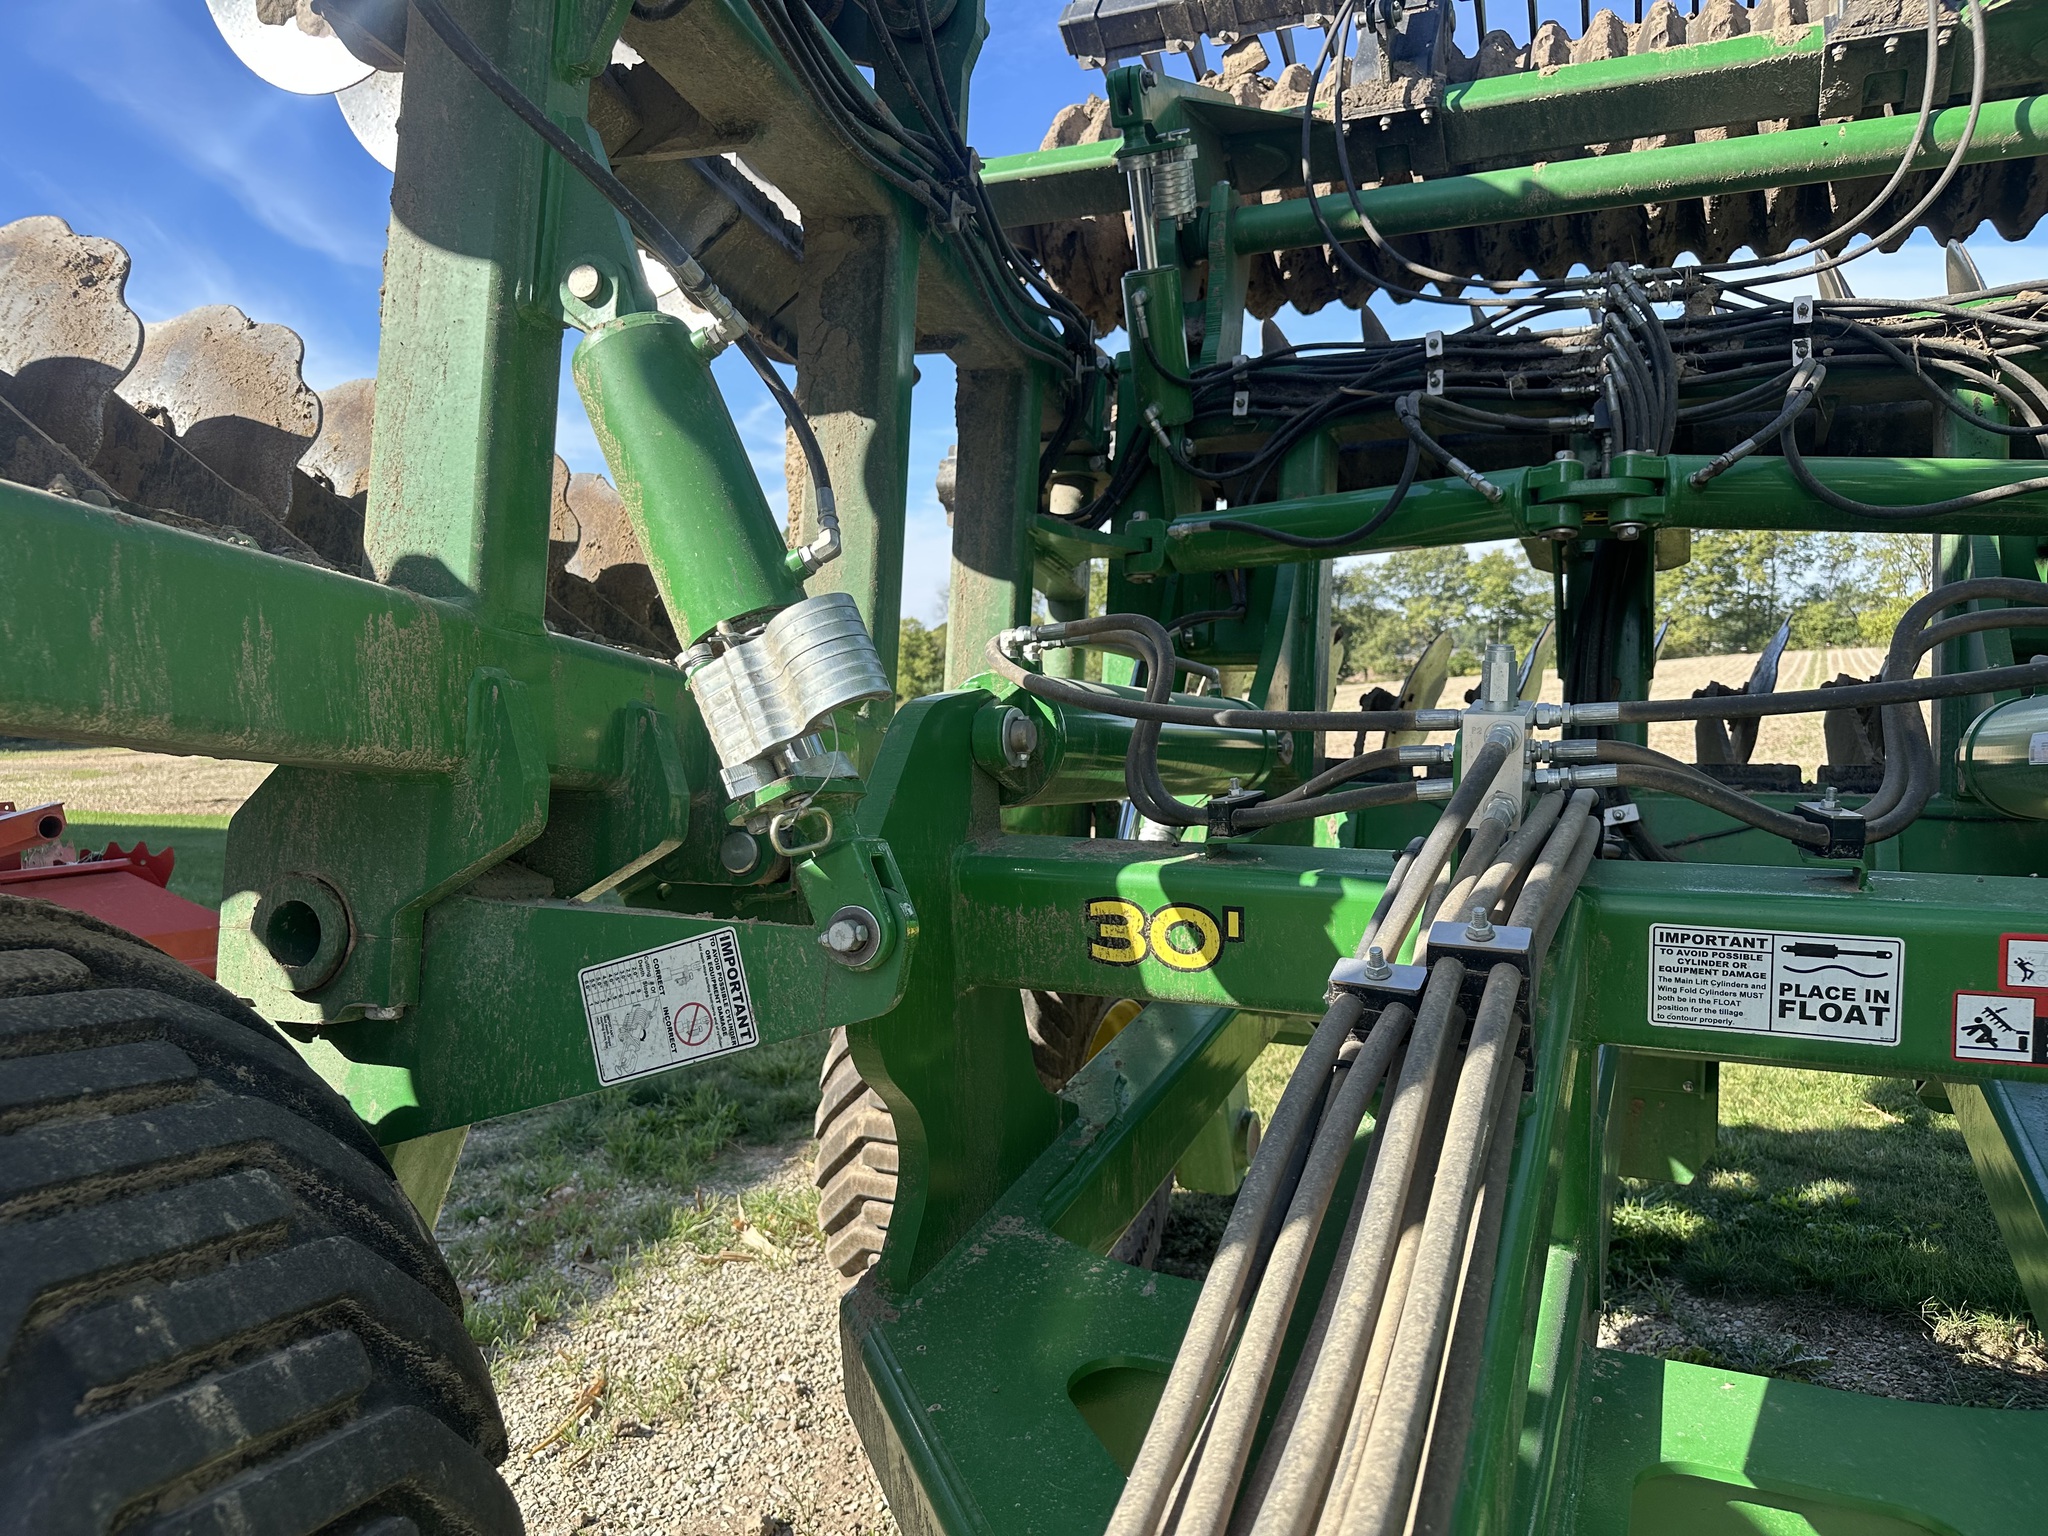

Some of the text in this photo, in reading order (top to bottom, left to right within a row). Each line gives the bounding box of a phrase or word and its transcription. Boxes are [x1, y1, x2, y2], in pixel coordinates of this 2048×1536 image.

[1085, 896, 1244, 973] 30'
[1659, 931, 1768, 949] IMPORTANT
[1676, 949, 1708, 957] AVOID
[1712, 951, 1762, 961] POSSIBLE
[1677, 958, 1729, 967] CYLINDER
[637, 959, 645, 977] Depth
[642, 955, 652, 977] Cutting
[1658, 965, 1766, 979] EQUIPMENT DAMAGE
[652, 957, 665, 996] CORRECT
[1710, 979, 1748, 989] Cylinders
[641, 980, 650, 998] Stops
[704, 949, 728, 1036] OR EQUIPMENT DAMAGE
[708, 936, 737, 1046] TO AVOID POSSIBLE CYLINDER
[718, 934, 753, 1040] IMPORTANT
[1657, 985, 1677, 993] Wing
[1699, 988, 1736, 998] Cylinders
[1739, 991, 1763, 999] MUST
[1779, 982, 1889, 1004] PLACE IN
[1657, 1003, 1688, 1012] position
[1718, 1008, 1743, 1017] tillage
[1713, 998, 1741, 1006] FLOAT
[1699, 1016, 1734, 1025] properly.
[1778, 998, 1890, 1027] FLOAT
[662, 1006, 677, 1054] INCORRECT
